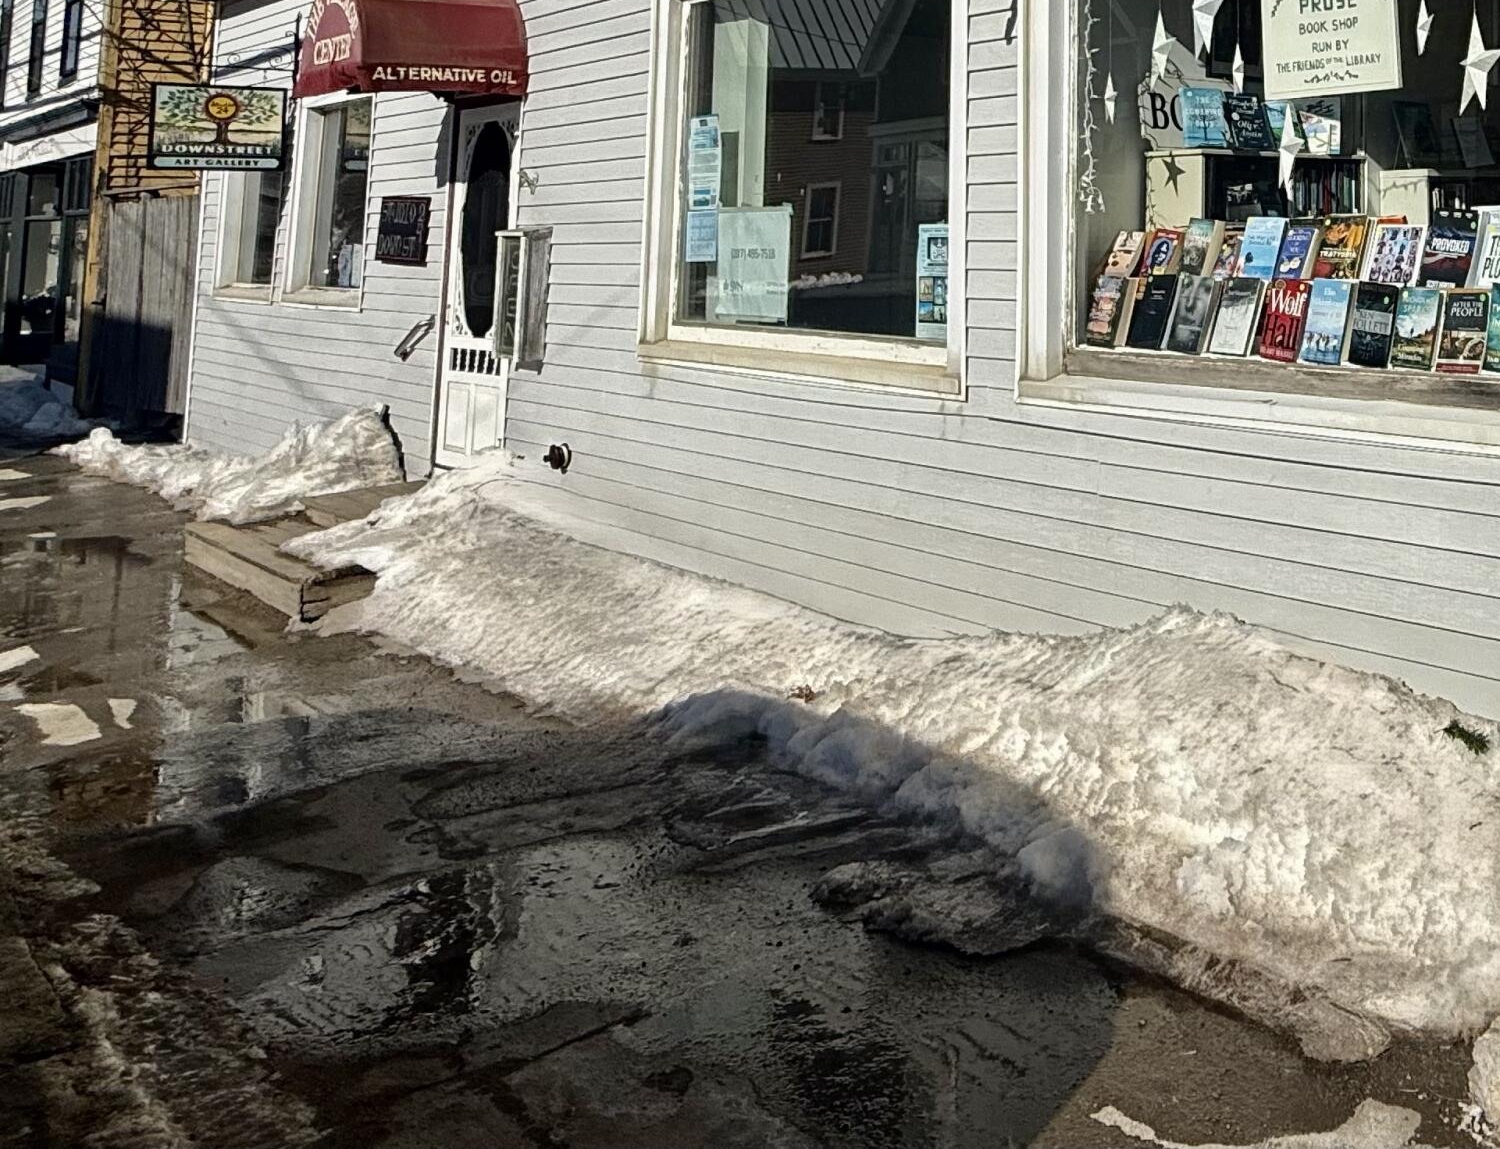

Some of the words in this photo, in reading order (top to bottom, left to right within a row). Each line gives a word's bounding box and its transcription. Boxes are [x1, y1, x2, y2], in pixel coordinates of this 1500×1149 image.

[1299, 20, 1329, 35] BOOK
[1332, 16, 1359, 31] SHOP
[313, 33, 352, 66] CENTER
[1312, 41, 1332, 53] RUN
[1335, 39, 1350, 51] BY
[1276, 61, 1292, 74] THE
[1292, 57, 1325, 72] FRIENDS
[1345, 53, 1382, 67] LIBRARY
[372, 66, 487, 82] ALTERNATIVE
[490, 70, 518, 84] OIL
[161, 144, 273, 155] DOWNSTREET
[174, 158, 198, 166] ART
[204, 158, 260, 166] GALLERY
[1431, 238, 1471, 253] PROVOKED
[1270, 288, 1308, 317] Wolf
[1450, 306, 1484, 317] PEOPLE
[1352, 317, 1390, 333] FOLLETT
[1491, 319, 1500, 328] IN
[1261, 314, 1301, 351] Hall
